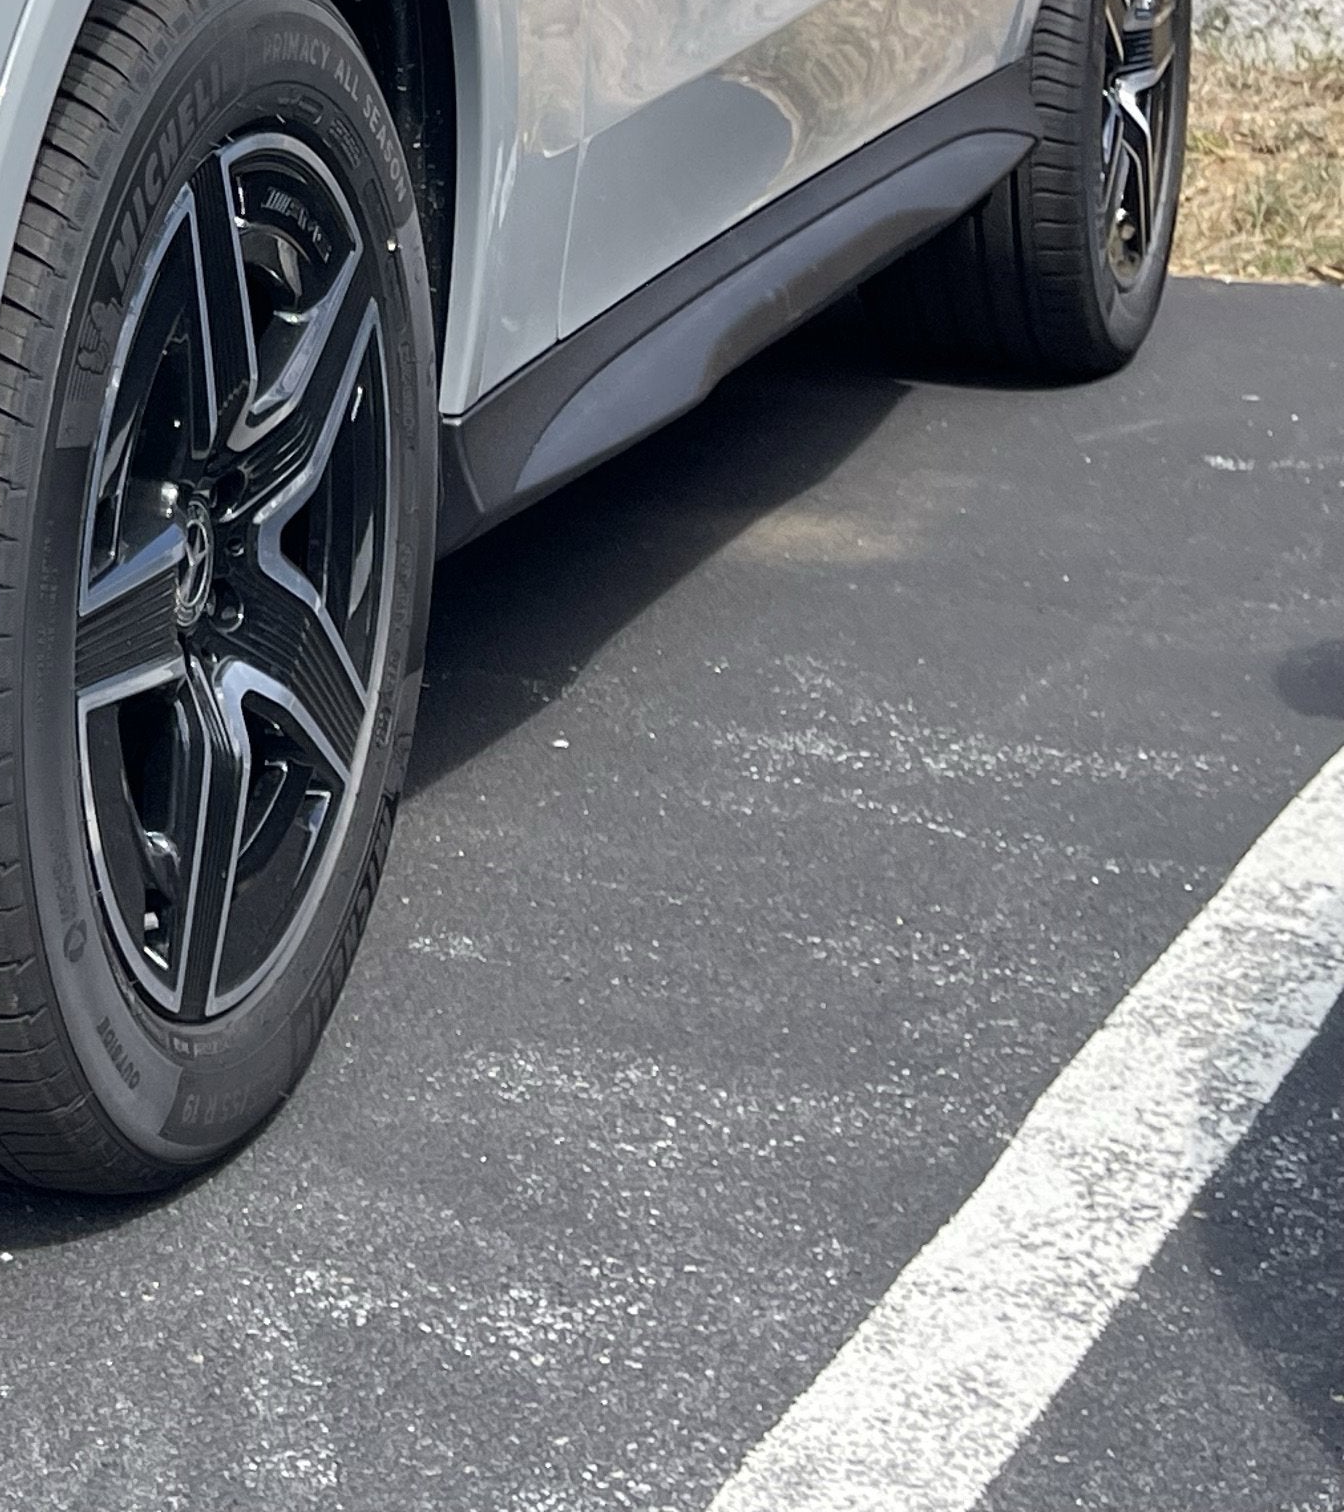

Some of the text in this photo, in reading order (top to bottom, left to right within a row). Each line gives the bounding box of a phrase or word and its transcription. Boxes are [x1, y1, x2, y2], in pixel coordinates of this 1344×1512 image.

[109, 54, 240, 292] MICHELI
[261, 31, 332, 71] PRIMACY
[332, 58, 361, 103] ALL
[361, 93, 409, 204] SEASON
